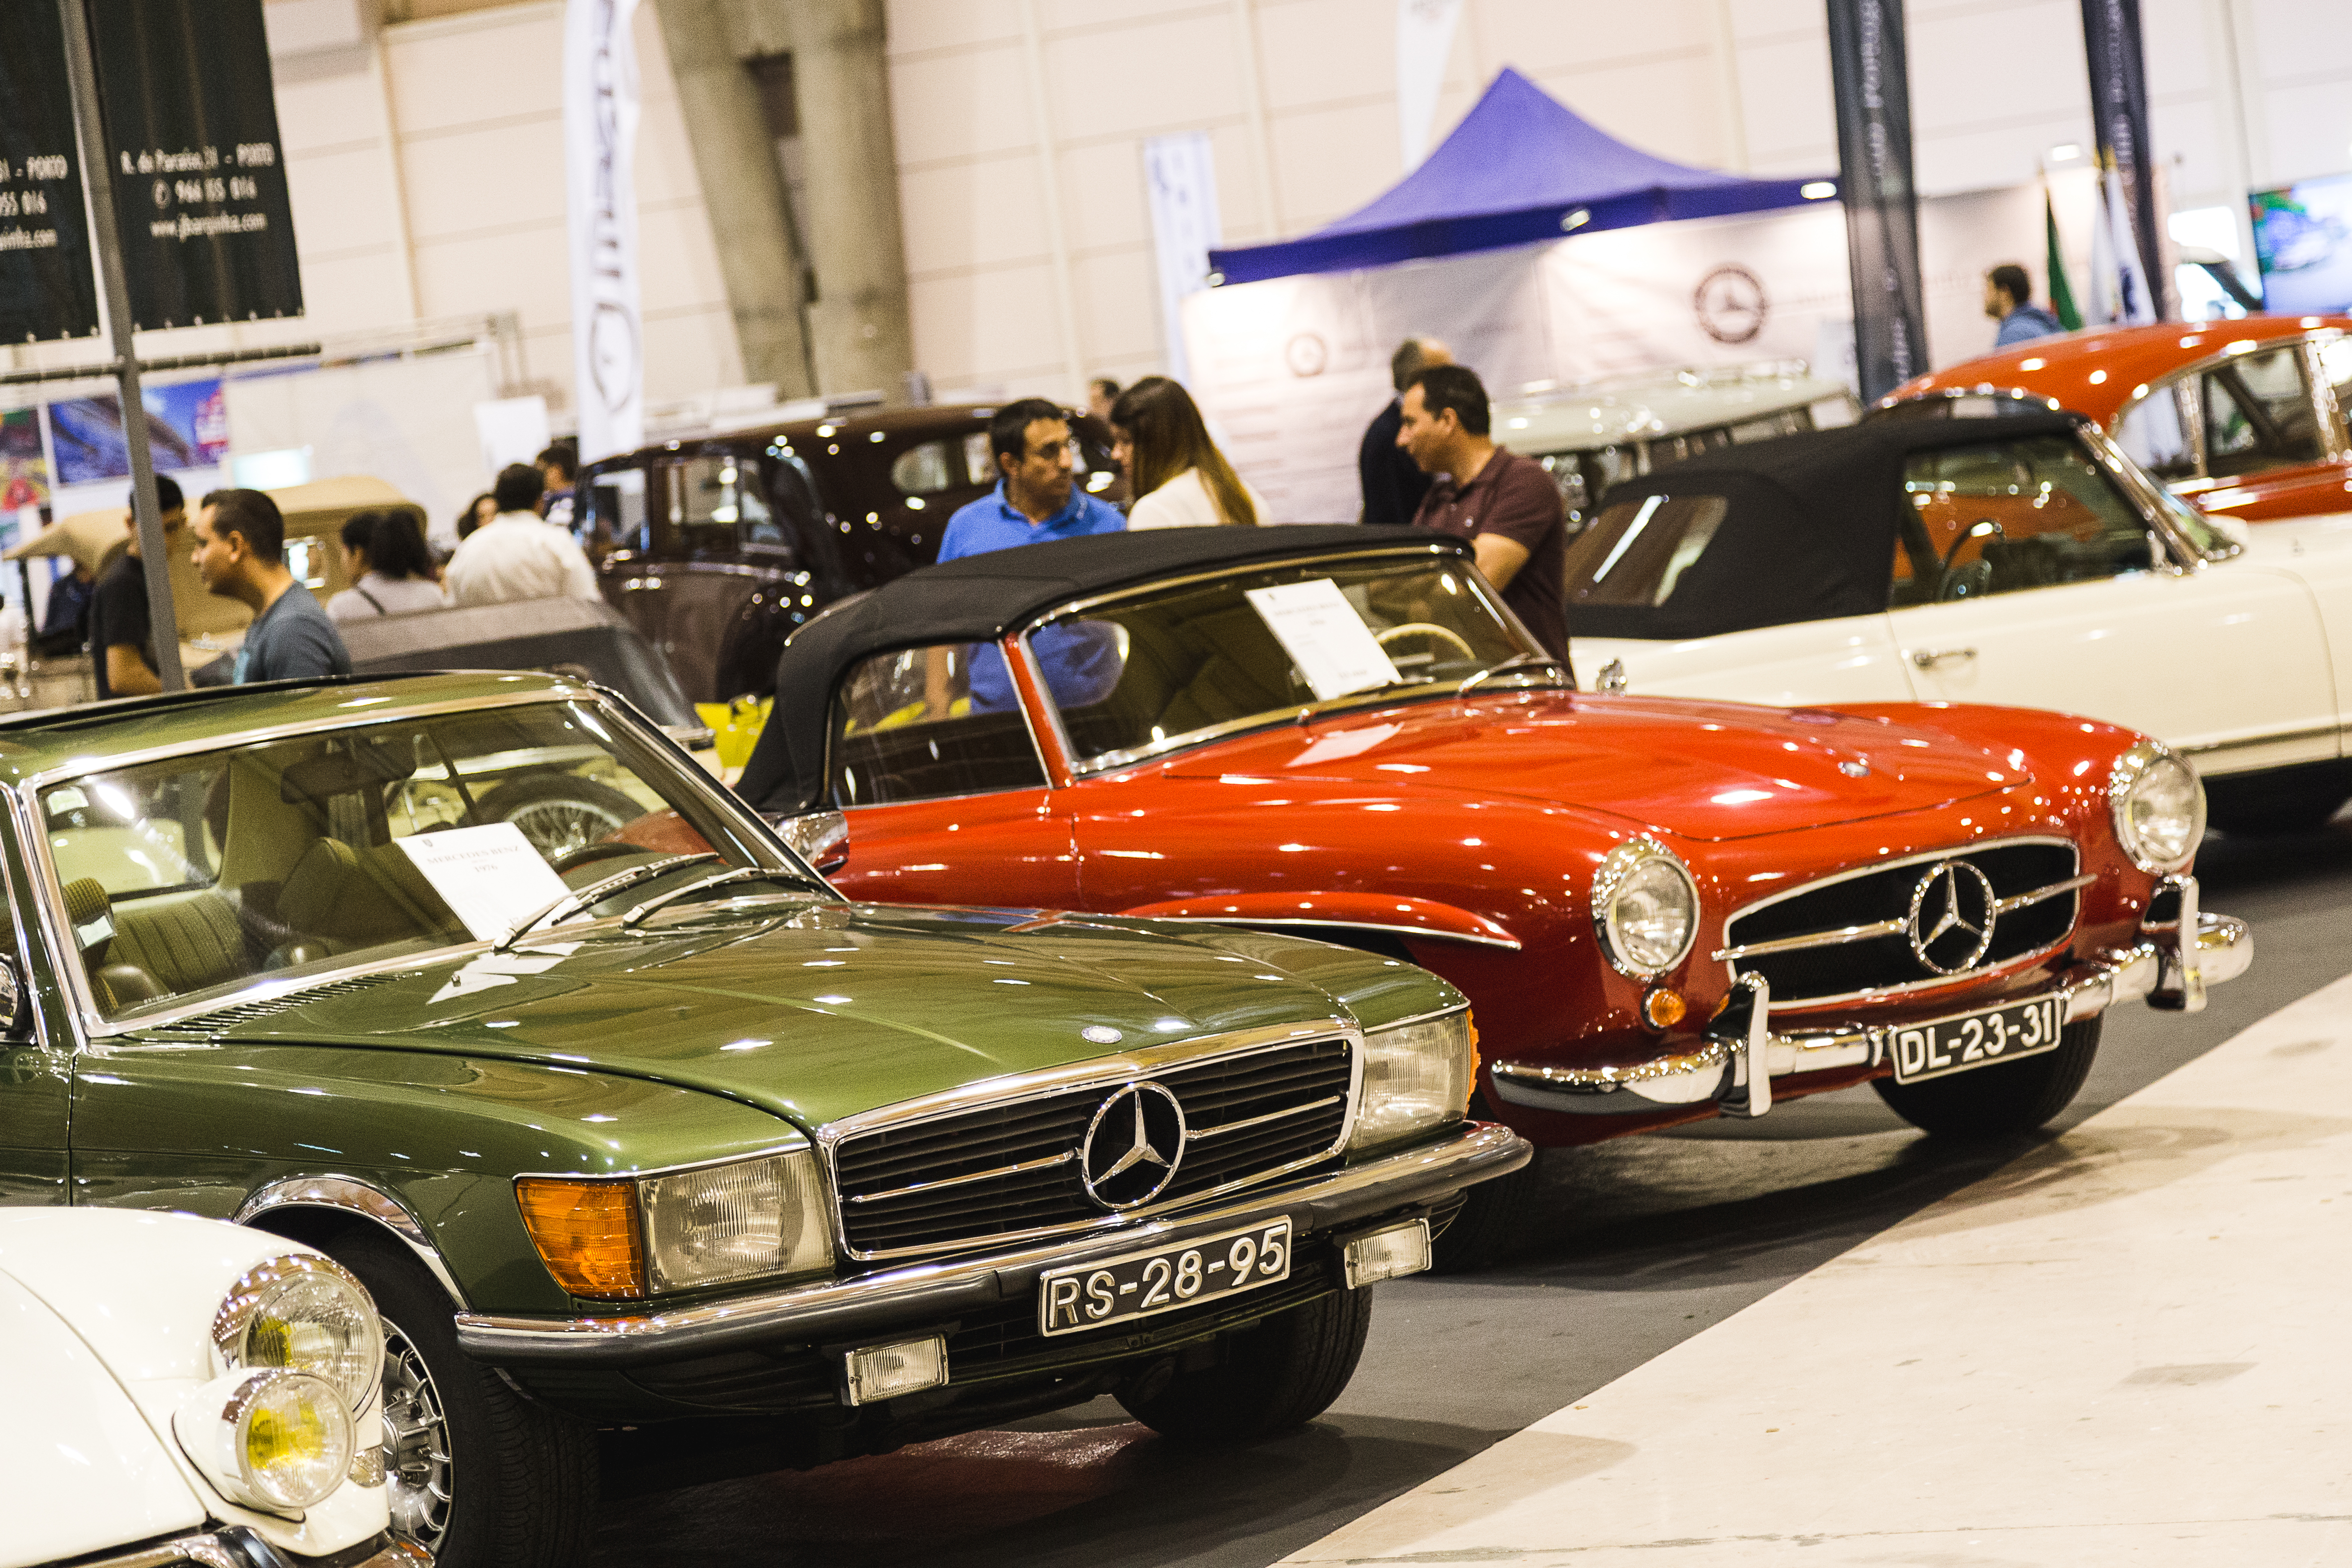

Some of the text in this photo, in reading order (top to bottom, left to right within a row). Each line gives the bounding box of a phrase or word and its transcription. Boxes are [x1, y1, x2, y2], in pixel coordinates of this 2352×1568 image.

[26, 154, 68, 181] PORTO
[236, 142, 275, 167] PORTO
[427, 845, 521, 864] MERCEDES BENZ
[474, 864, 499, 872] 1976
[1900, 1001, 2052, 1076] DL-23-31
[1049, 1225, 1288, 1328] RS-28-95
